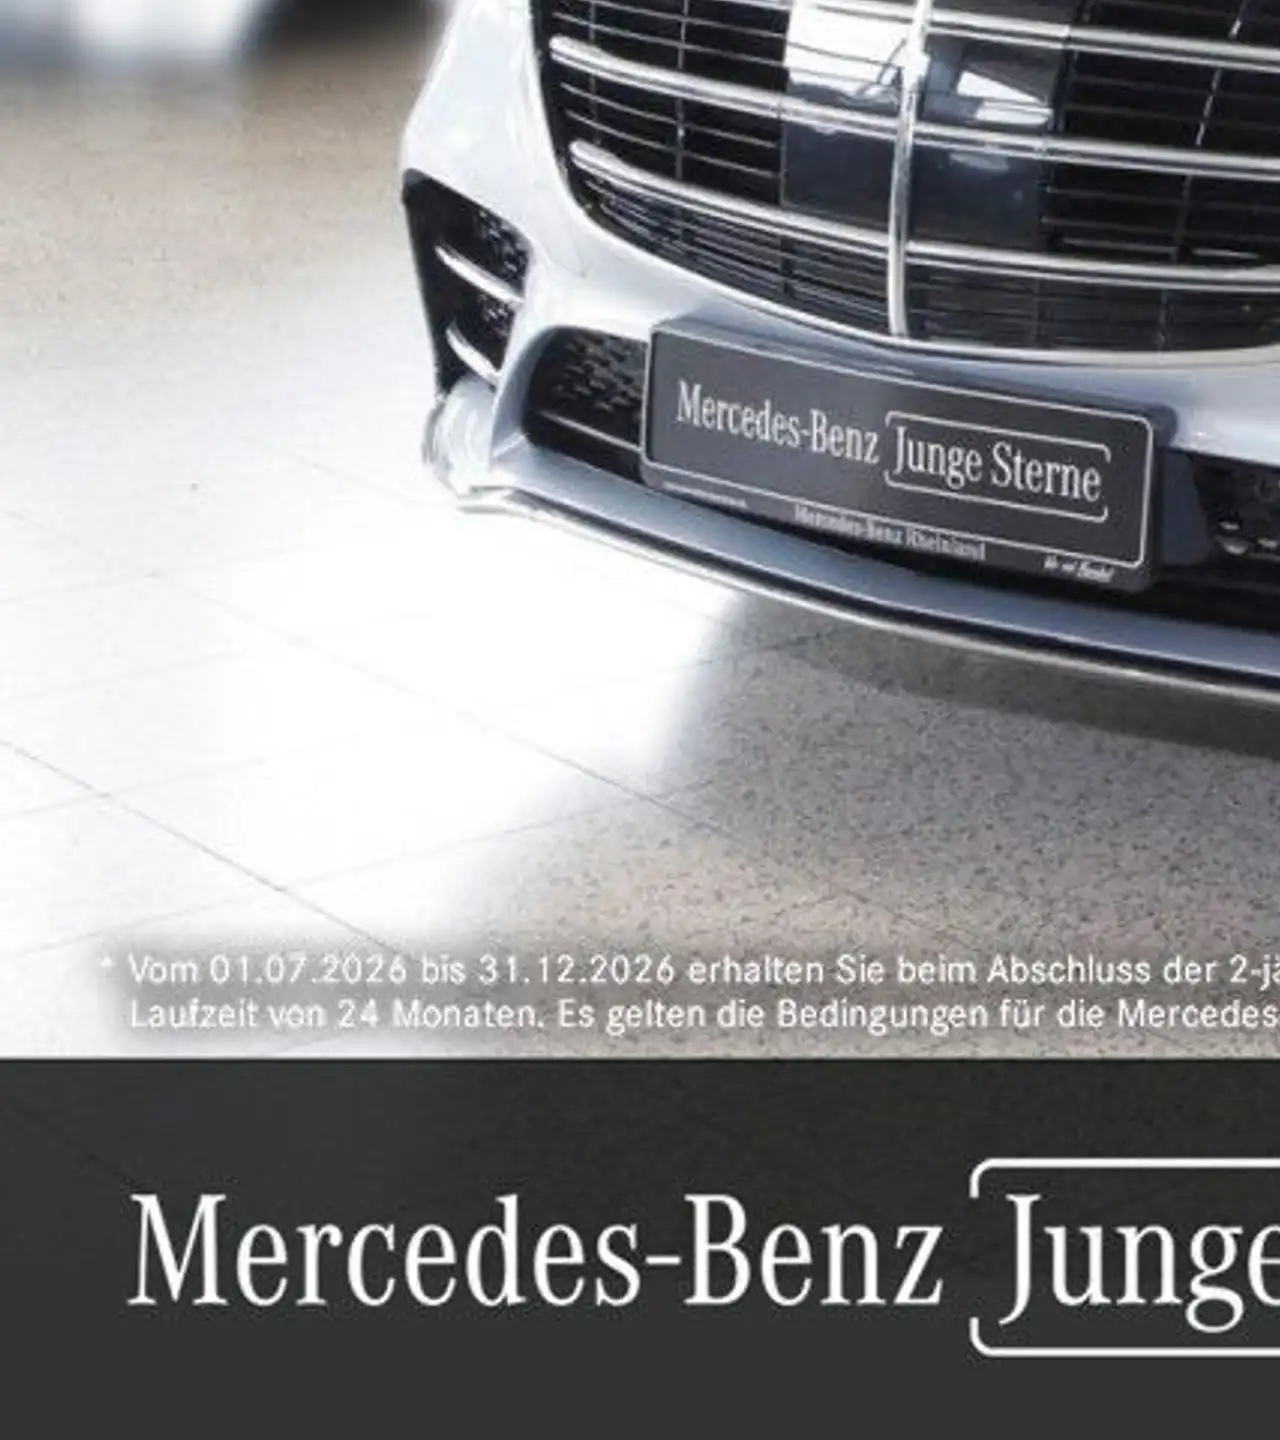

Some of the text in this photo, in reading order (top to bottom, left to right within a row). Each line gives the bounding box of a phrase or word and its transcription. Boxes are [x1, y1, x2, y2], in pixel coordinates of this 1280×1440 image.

[676, 378, 1101, 503] Mercedes-Benz Junge Sterne
